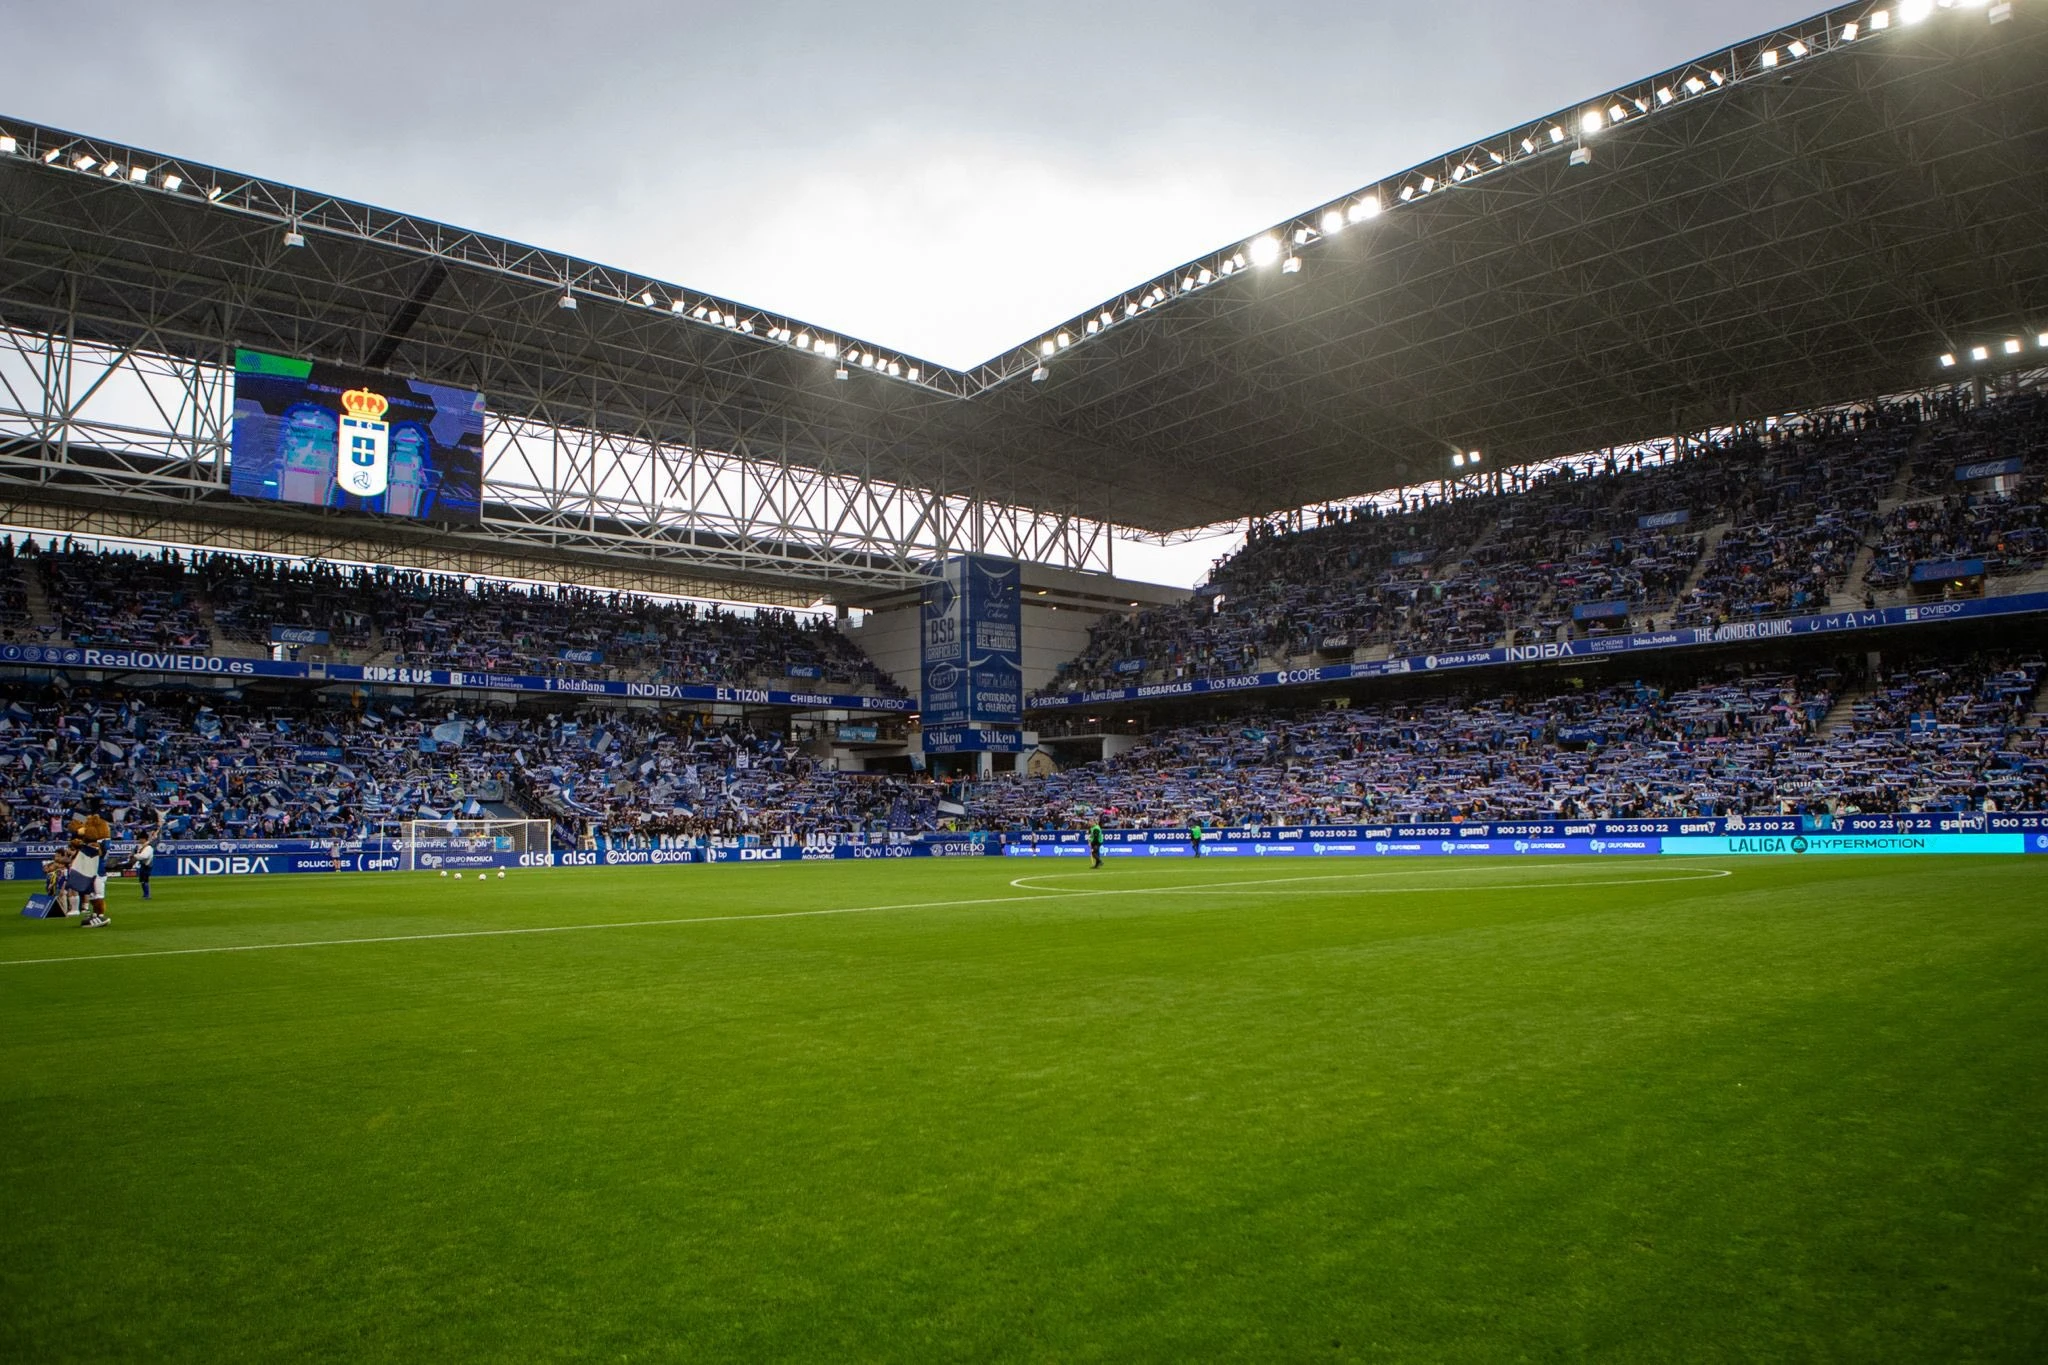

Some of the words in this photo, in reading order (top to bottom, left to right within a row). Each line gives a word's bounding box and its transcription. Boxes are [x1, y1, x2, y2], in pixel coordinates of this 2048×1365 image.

[1920, 604, 1960, 615] OVIEDO
[931, 618, 954, 644] BSB
[1694, 629, 1712, 642] THE
[1714, 624, 1756, 640] WONDER
[1758, 620, 1792, 636] CLINIC
[1633, 635, 1677, 646] blau.hotels
[1506, 642, 1573, 661] INDIBA
[84, 649, 254, 674] RealOVIEDO.es
[1438, 656, 1464, 666] TIERRA
[363, 667, 395, 681] KIDS
[399, 668, 410, 682] &
[412, 670, 432, 683] US
[1289, 668, 1320, 682] COPE
[1138, 682, 1192, 696] BSBGRAFICA.ES
[1210, 679, 1225, 690] LOS
[1227, 675, 1259, 687] PRADOS
[627, 683, 682, 697] INDIBA
[716, 688, 732, 700] EL
[872, 698, 904, 709] OVIEDO
[929, 732, 962, 745] Silken
[980, 730, 1016, 744] Silken
[1725, 822, 1746, 831] 900
[1749, 822, 1761, 830] 23
[1764, 822, 1778, 830] 00
[1780, 822, 1795, 830] 22
[1853, 820, 1876, 828] 900
[1879, 820, 1894, 828] 23
[1916, 819, 1931, 828] 22
[1992, 819, 2018, 827] 900
[2023, 818, 2038, 827] 23
[945, 844, 984, 852] OVIEDO
[1730, 838, 1785, 852] LALIGA
[1811, 839, 1924, 849] HYPERMOTION
[520, 852, 554, 866] alsa
[562, 852, 596, 865] alsa
[719, 851, 727, 859] bp
[741, 849, 781, 860] DIGI
[178, 856, 269, 875] INDIBA
[298, 860, 351, 869] SOLUCIOES
